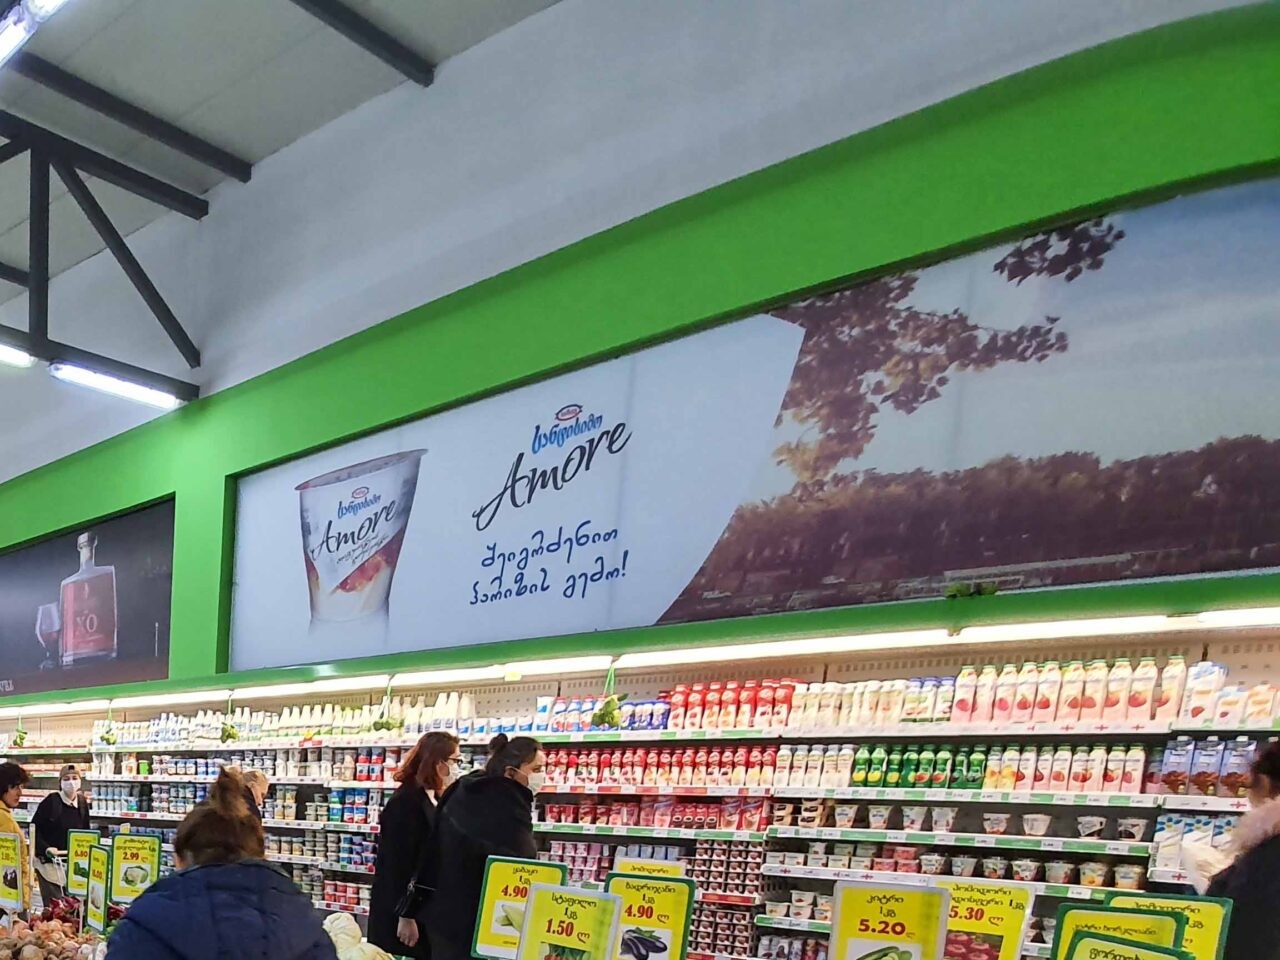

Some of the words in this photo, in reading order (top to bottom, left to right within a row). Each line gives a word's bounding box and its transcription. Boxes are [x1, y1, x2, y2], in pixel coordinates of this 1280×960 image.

[472, 422, 633, 531] Amore
[310, 500, 396, 559] Amore
[122, 852, 140, 860] 2.99
[501, 884, 528, 899] 4.90
[952, 883, 1012, 897] პომიდორი
[551, 892, 597, 909] სტაფილო
[624, 904, 654, 919] 4.90
[948, 905, 985, 921] 5.30
[988, 916, 1004, 926] ლ
[546, 918, 574, 937] 1.50
[576, 930, 590, 943] ლ
[858, 918, 906, 936] 5.20
